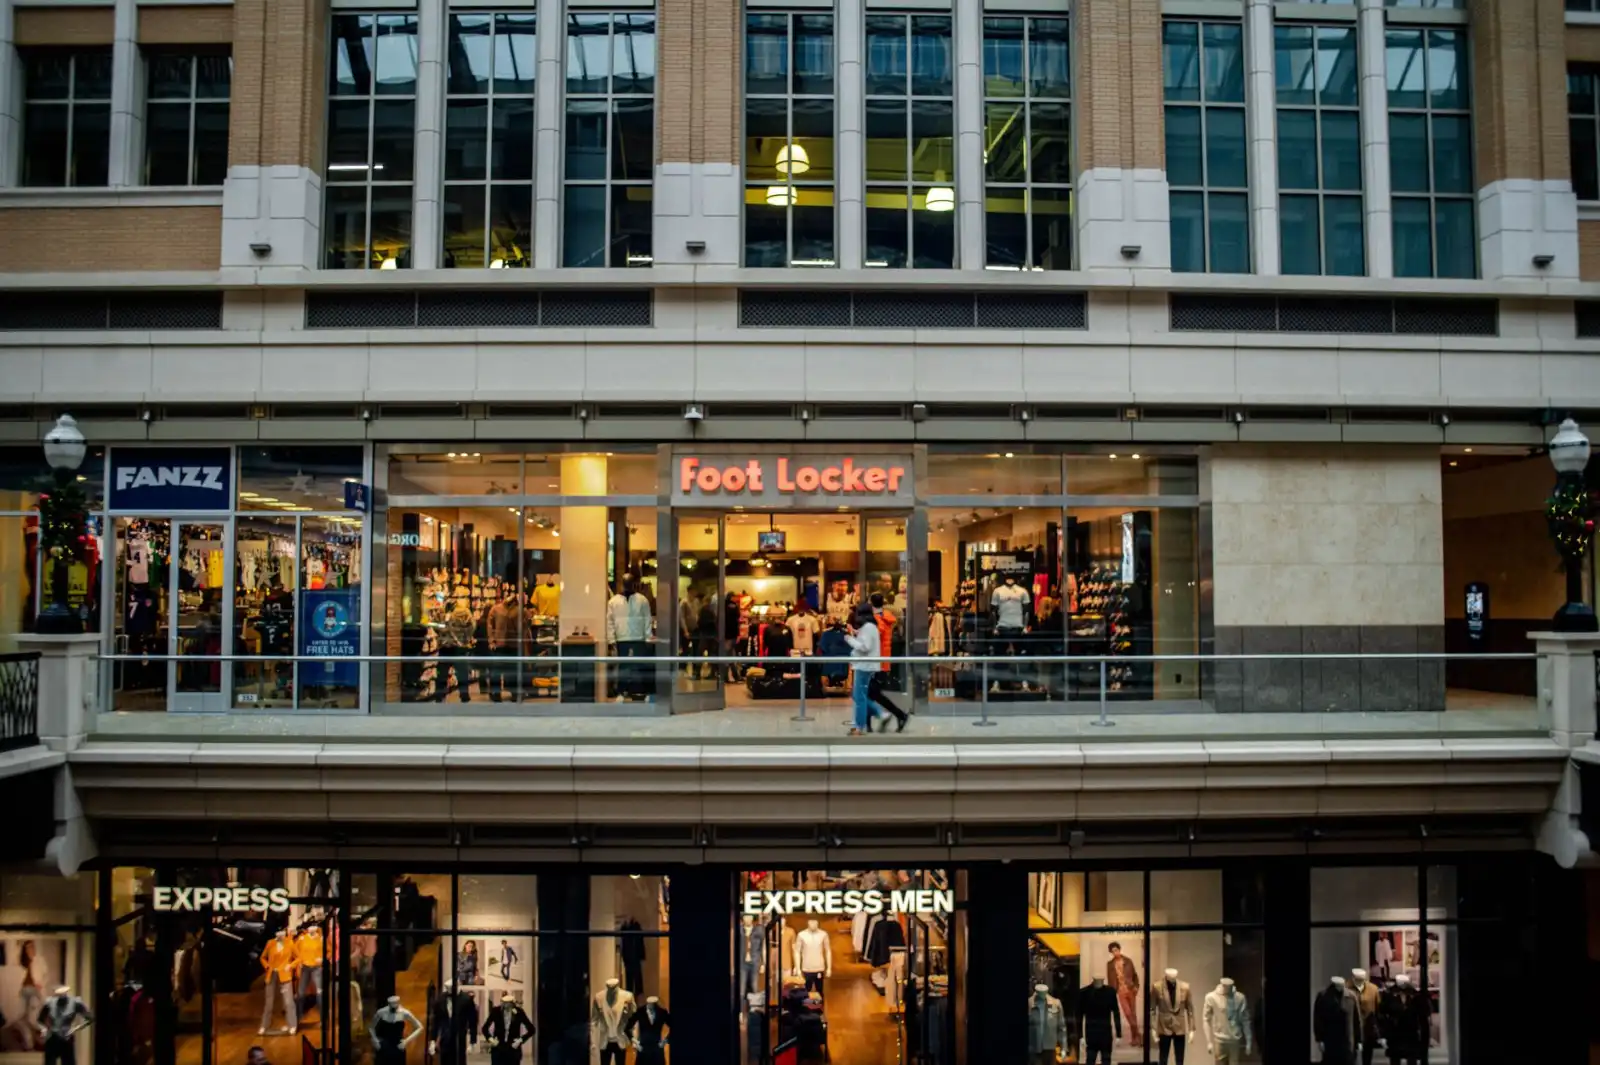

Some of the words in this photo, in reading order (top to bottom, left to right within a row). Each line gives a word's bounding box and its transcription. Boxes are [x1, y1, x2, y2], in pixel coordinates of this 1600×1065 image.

[116, 466, 223, 491] FANZZ
[680, 457, 763, 492] Foot
[777, 457, 905, 492] Locker
[306, 645, 328, 654] FREE
[331, 645, 354, 654] HATS
[153, 887, 289, 912] EXPRESS
[743, 890, 884, 914] EXPRESS
[890, 890, 954, 913] MEN
